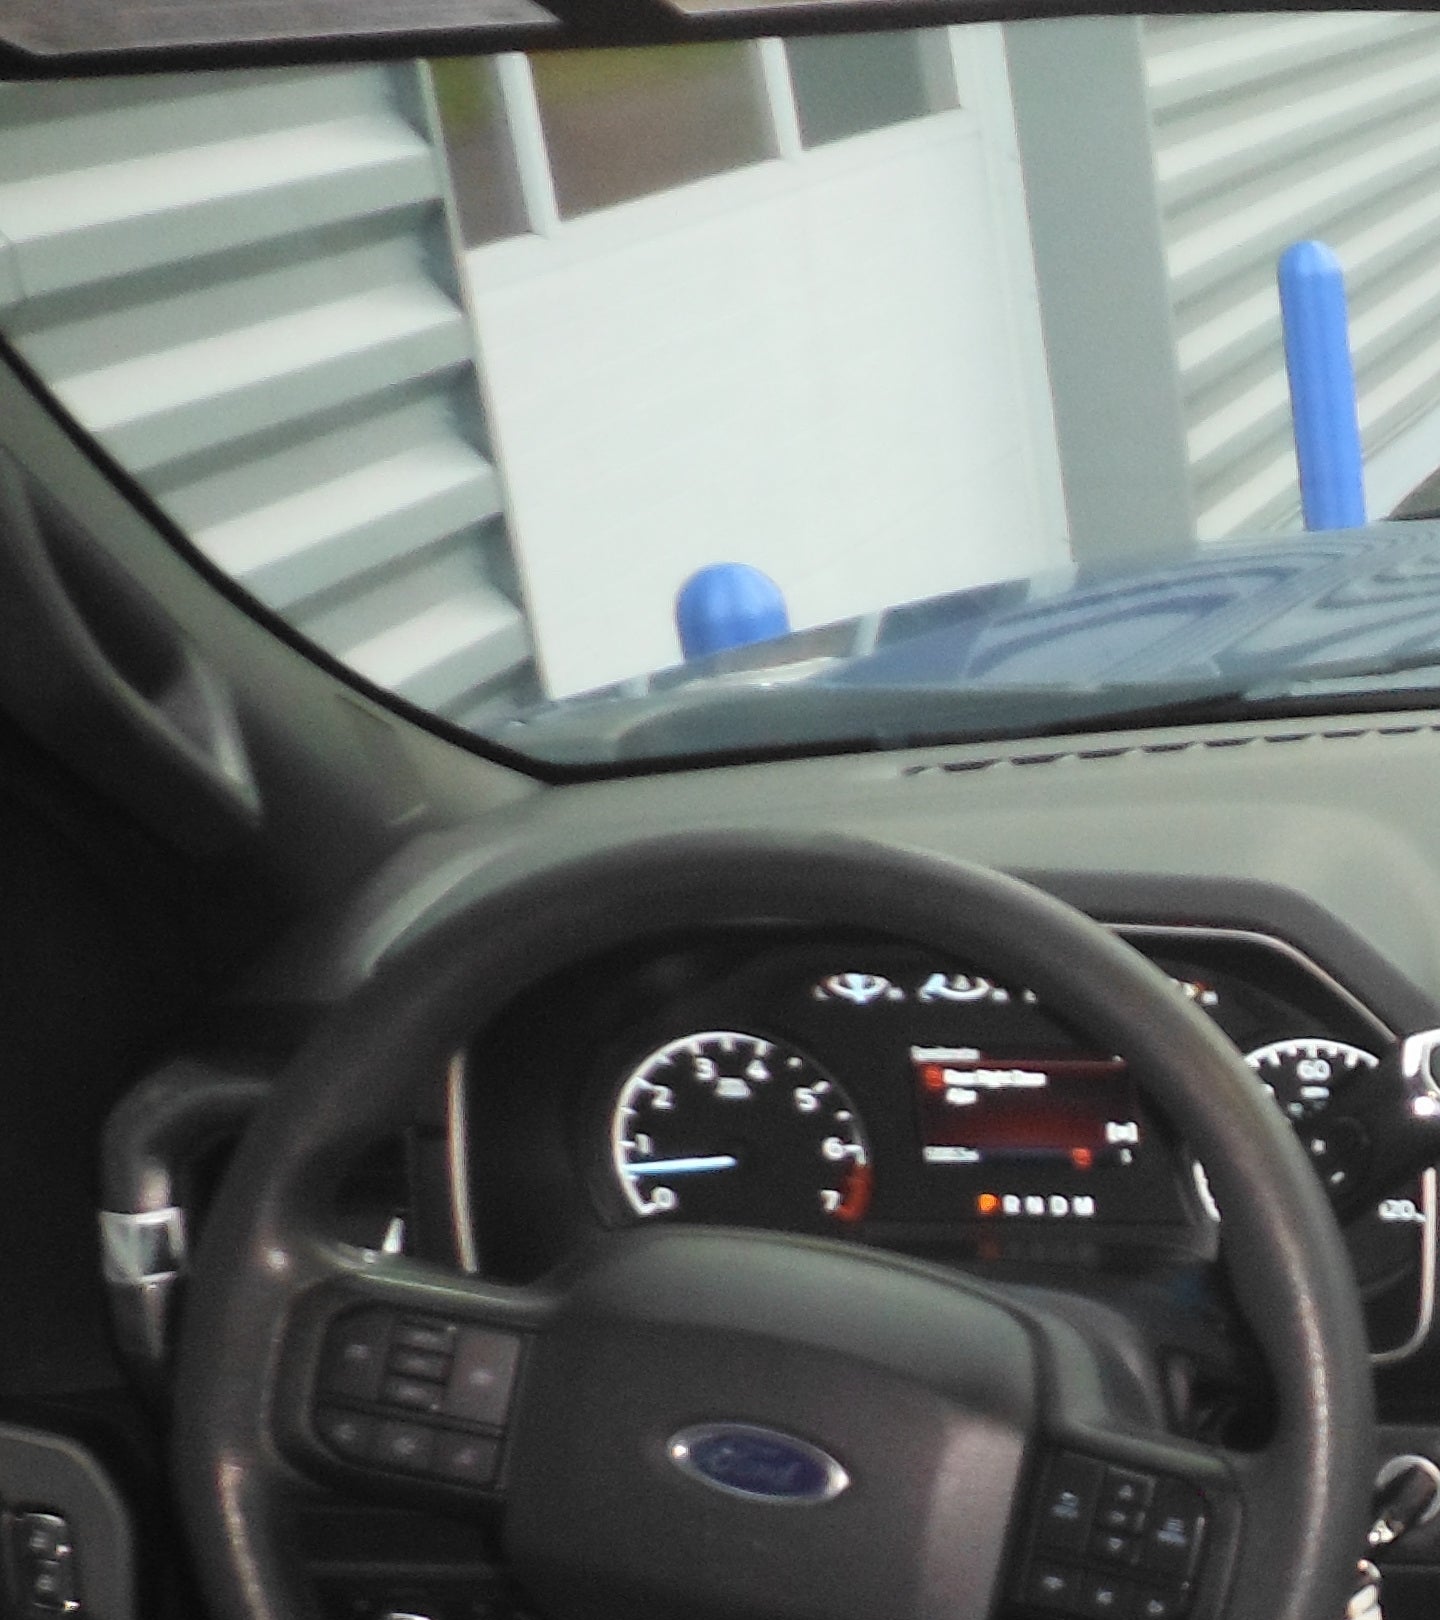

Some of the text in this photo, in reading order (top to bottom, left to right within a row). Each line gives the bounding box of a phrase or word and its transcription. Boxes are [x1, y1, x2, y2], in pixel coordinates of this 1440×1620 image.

[695, 1056, 716, 1080] 3
[746, 1059, 769, 1080] 4
[651, 1085, 674, 1110] 2
[794, 1087, 818, 1112] 5
[822, 1136, 845, 1160] 6
[653, 1186, 678, 1210] 0
[820, 1189, 842, 1212] 7
